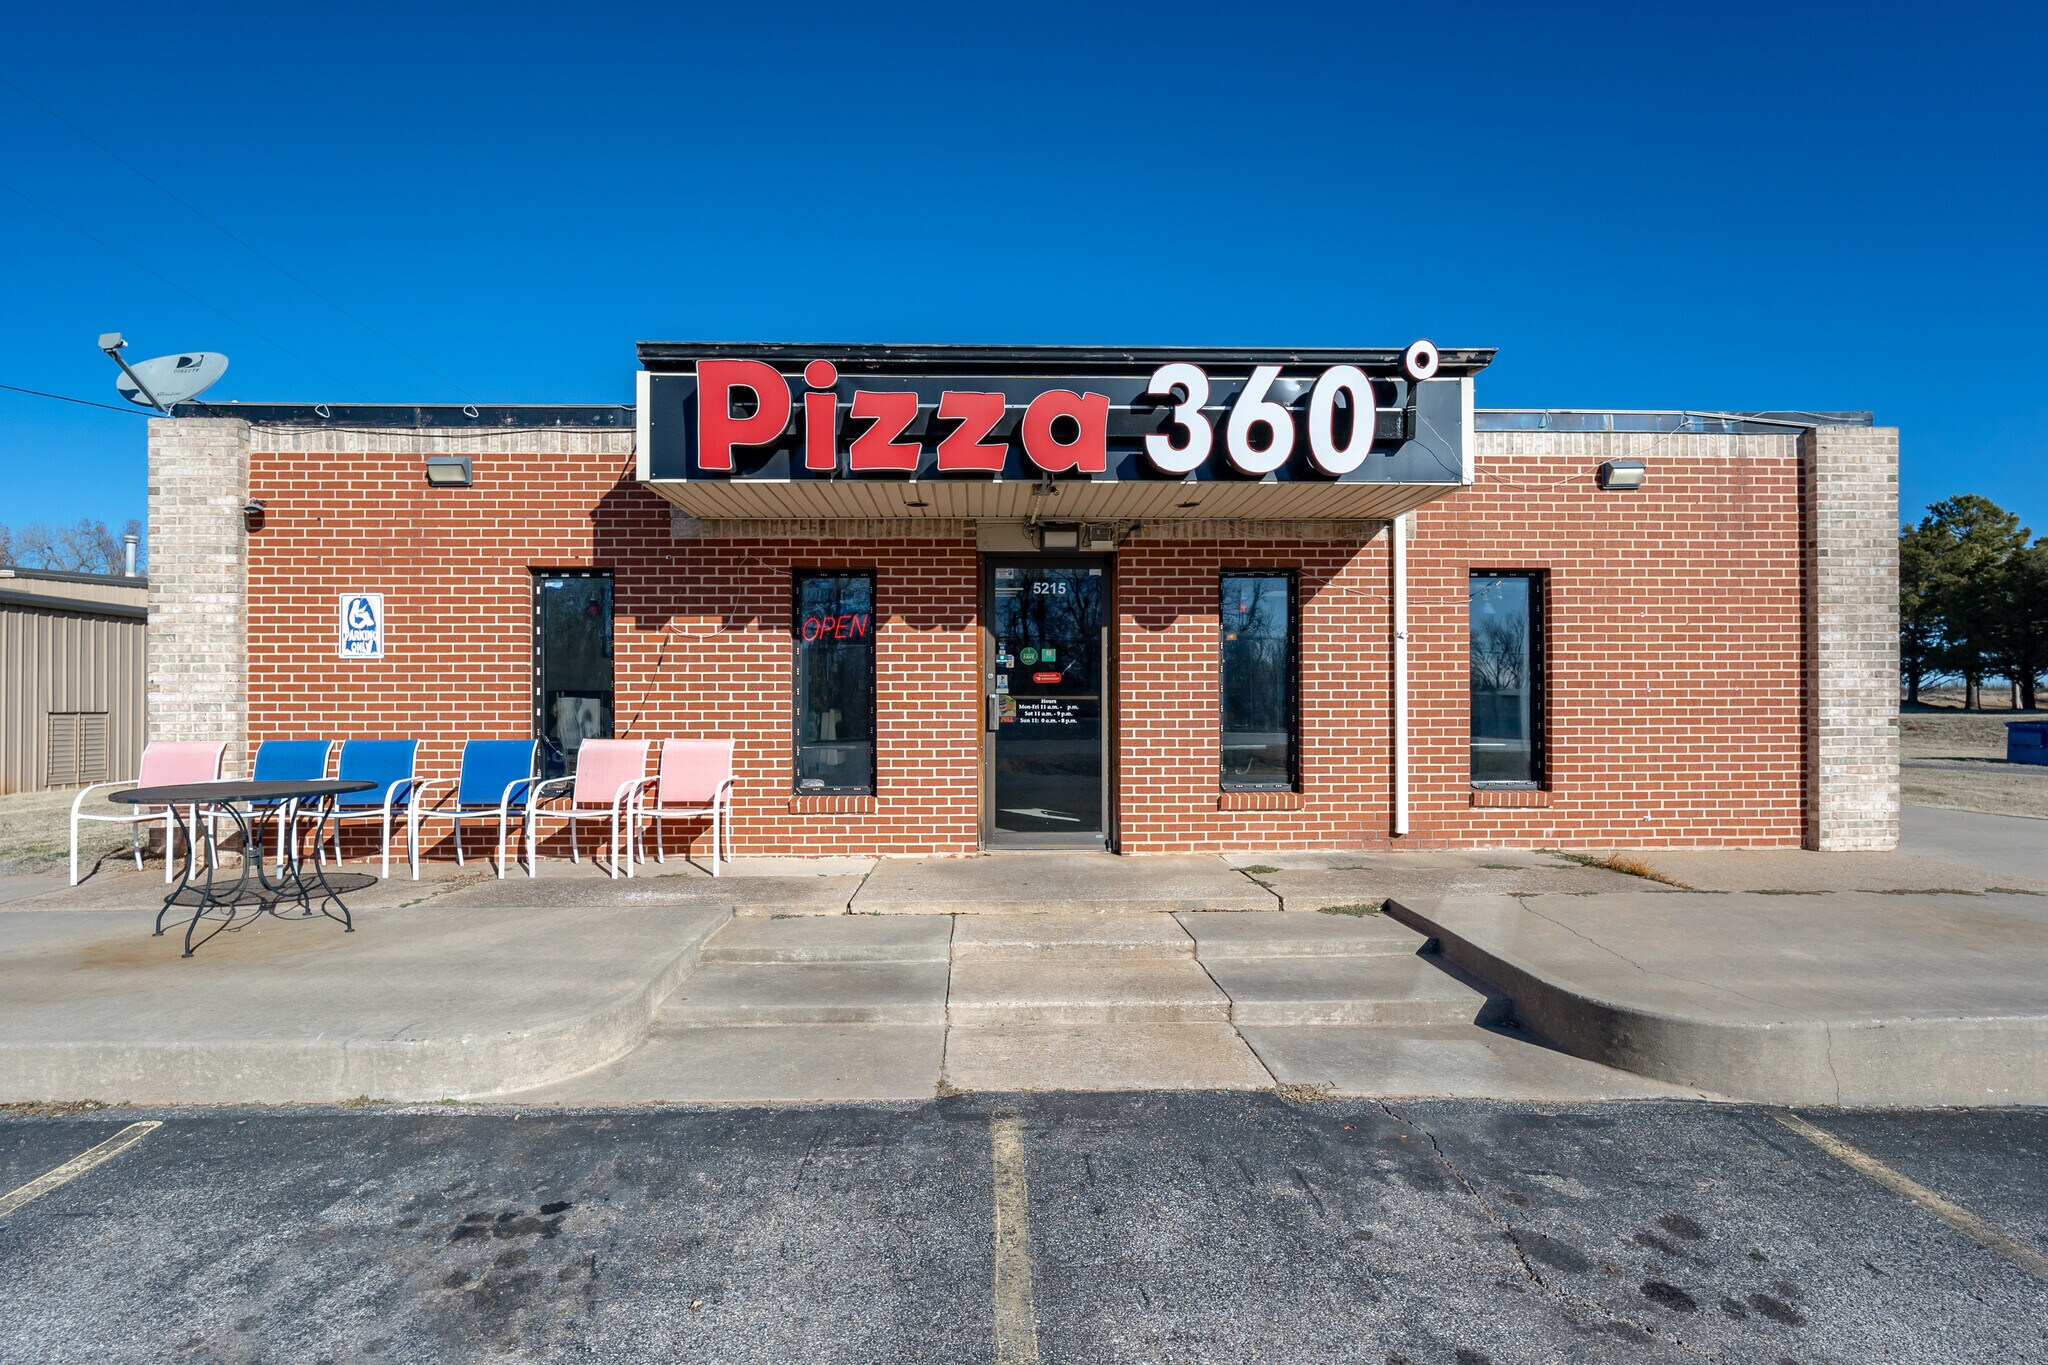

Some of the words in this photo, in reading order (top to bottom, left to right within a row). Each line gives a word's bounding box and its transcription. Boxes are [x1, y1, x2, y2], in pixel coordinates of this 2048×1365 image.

[694, 358, 1112, 474] Pizza
[1033, 582, 1066, 594] 5215
[802, 613, 869, 642] OPEN
[343, 629, 378, 641] PARKING
[351, 641, 371, 653] ONLY
